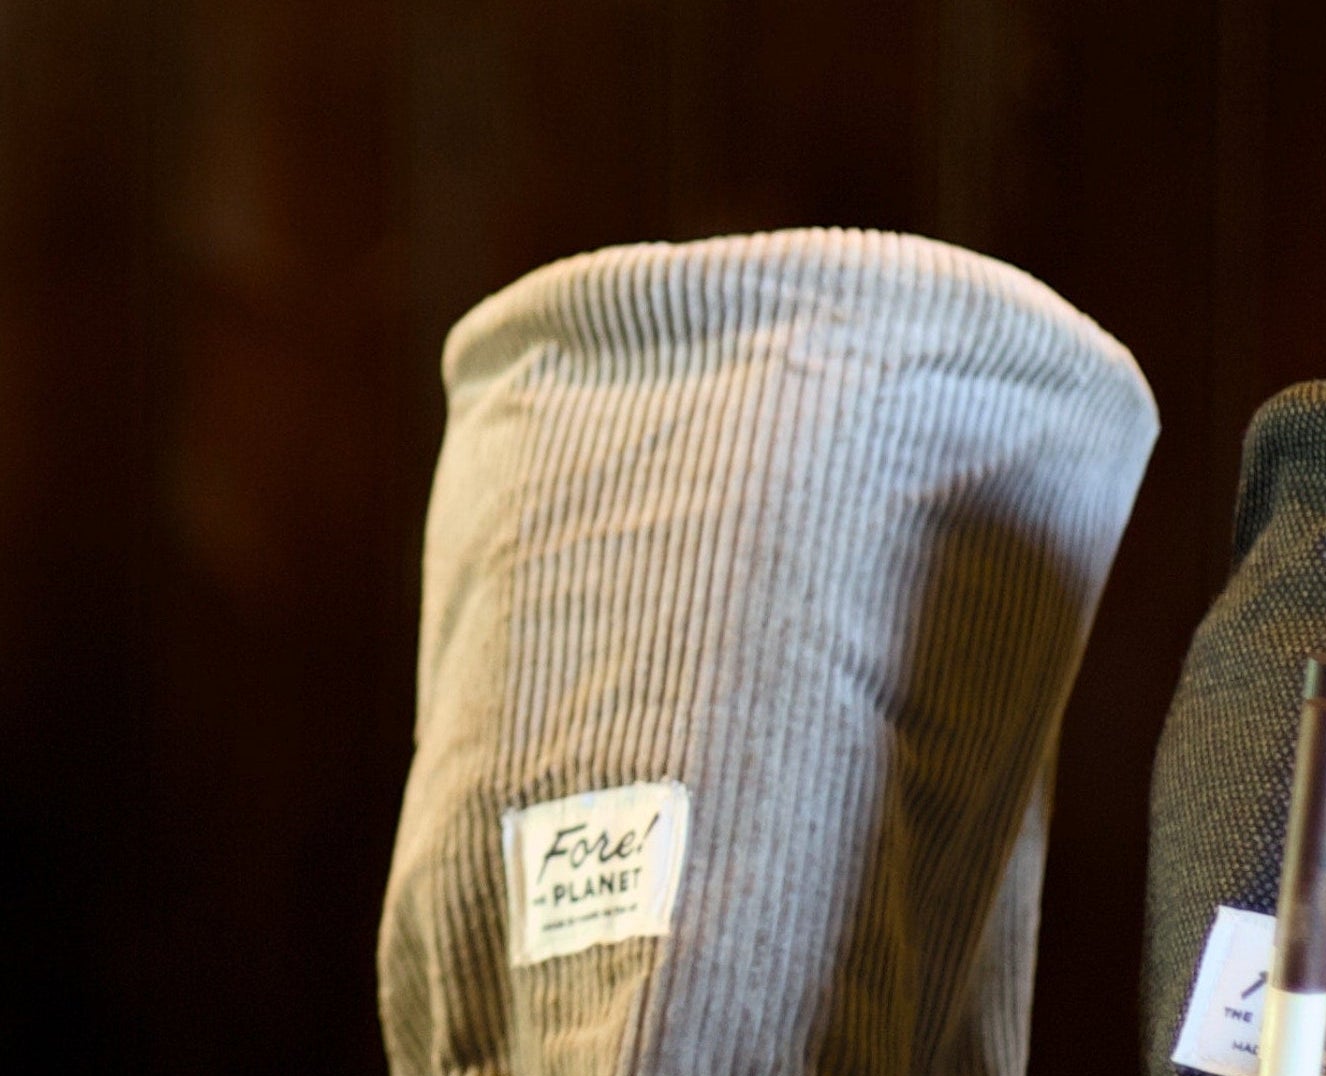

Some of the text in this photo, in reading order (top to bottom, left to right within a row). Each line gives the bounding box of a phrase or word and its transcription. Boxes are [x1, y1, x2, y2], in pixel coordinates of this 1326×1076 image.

[537, 813, 660, 884] Fore!
[552, 868, 643, 906] PLANET
[1224, 1006, 1253, 1023] THE
